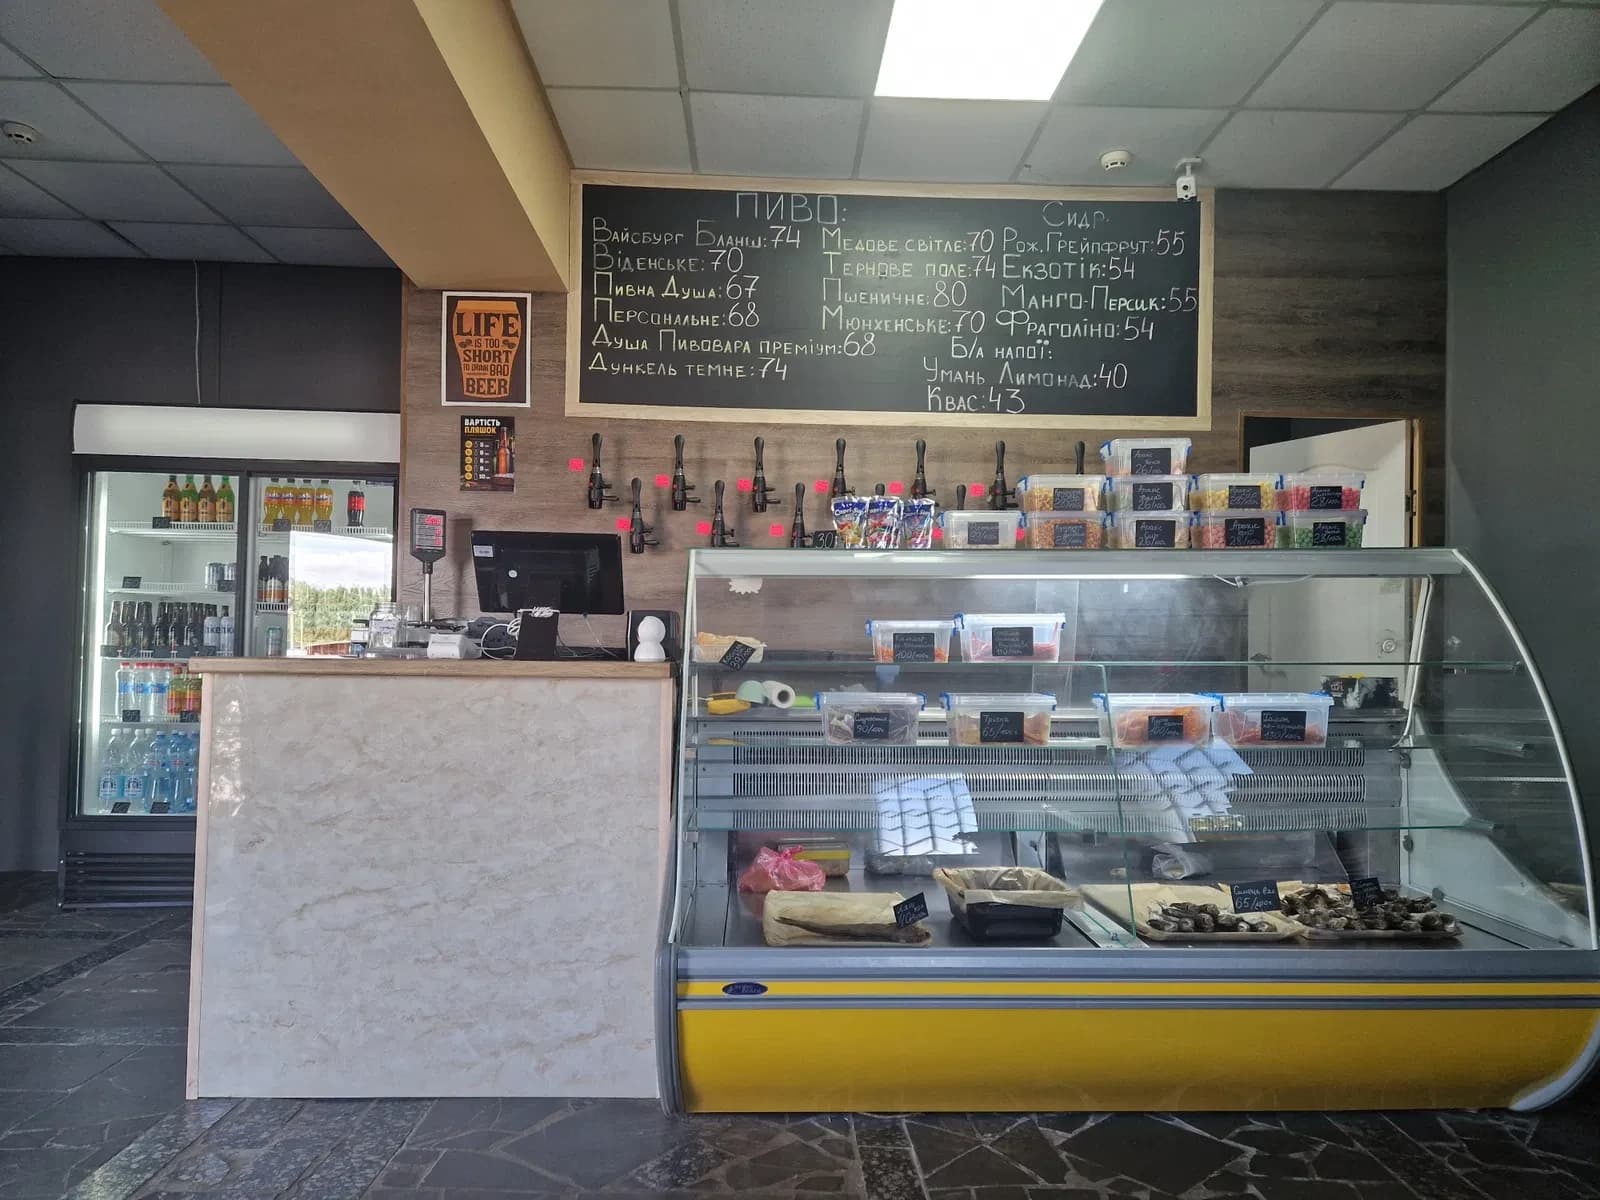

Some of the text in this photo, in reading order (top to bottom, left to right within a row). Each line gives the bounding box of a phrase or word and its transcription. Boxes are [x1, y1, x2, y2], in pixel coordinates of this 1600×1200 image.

[456, 312, 519, 337] LIFE
[474, 338, 500, 349] IS TOO
[463, 349, 512, 363] SHORT
[490, 364, 510, 376] BAD
[465, 378, 508, 395] BEER
[464, 418, 501, 427] ВАРТІСТЬ
[464, 426, 497, 434] ПЛЯШОК
[816, 532, 834, 548] 30
